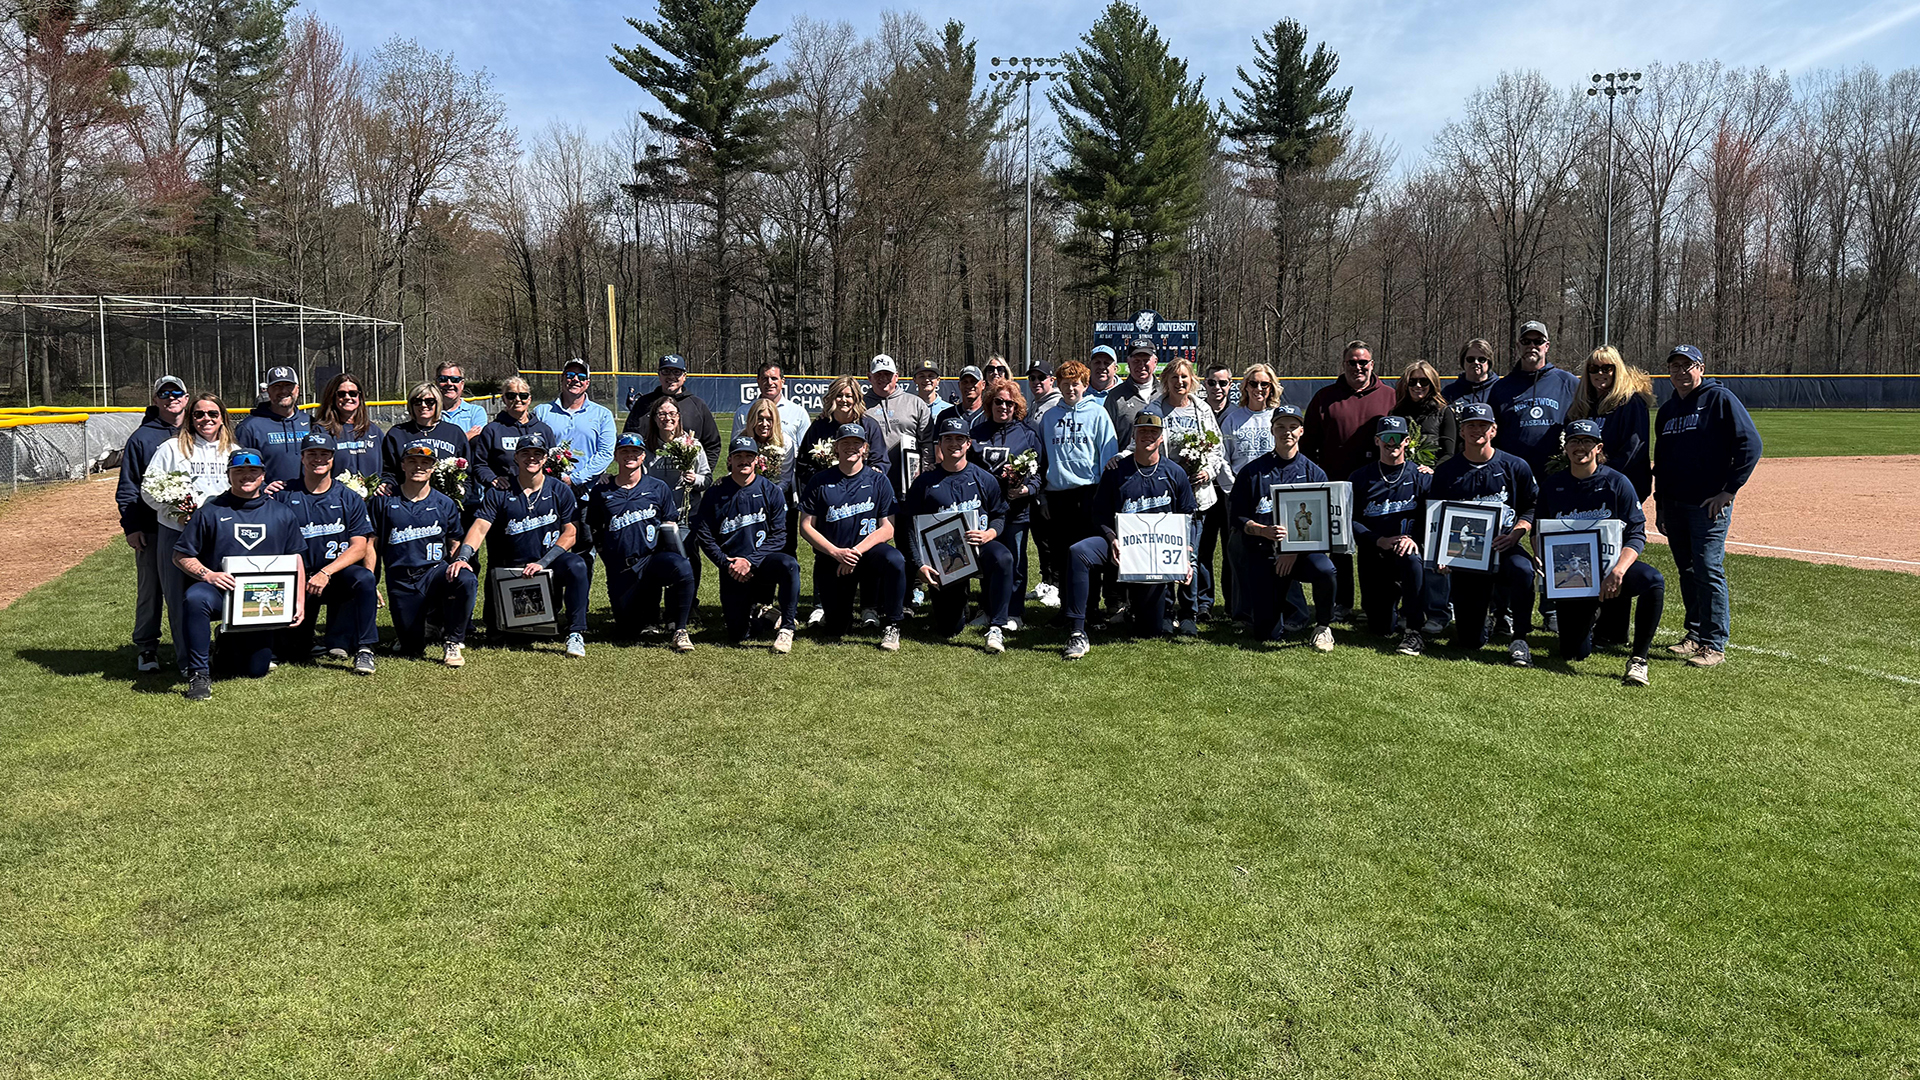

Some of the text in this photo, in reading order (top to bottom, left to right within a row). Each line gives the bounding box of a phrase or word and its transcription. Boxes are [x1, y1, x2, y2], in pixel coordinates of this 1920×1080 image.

[1095, 322, 1196, 332] NORTHWOOD UNIVERSITY
[924, 360, 932, 368] C
[825, 496, 875, 522] Northwood
[388, 520, 443, 545] Northwood
[1122, 533, 1184, 547] NORTHWOOD
[425, 542, 444, 561] 15
[1161, 549, 1183, 565] 37
